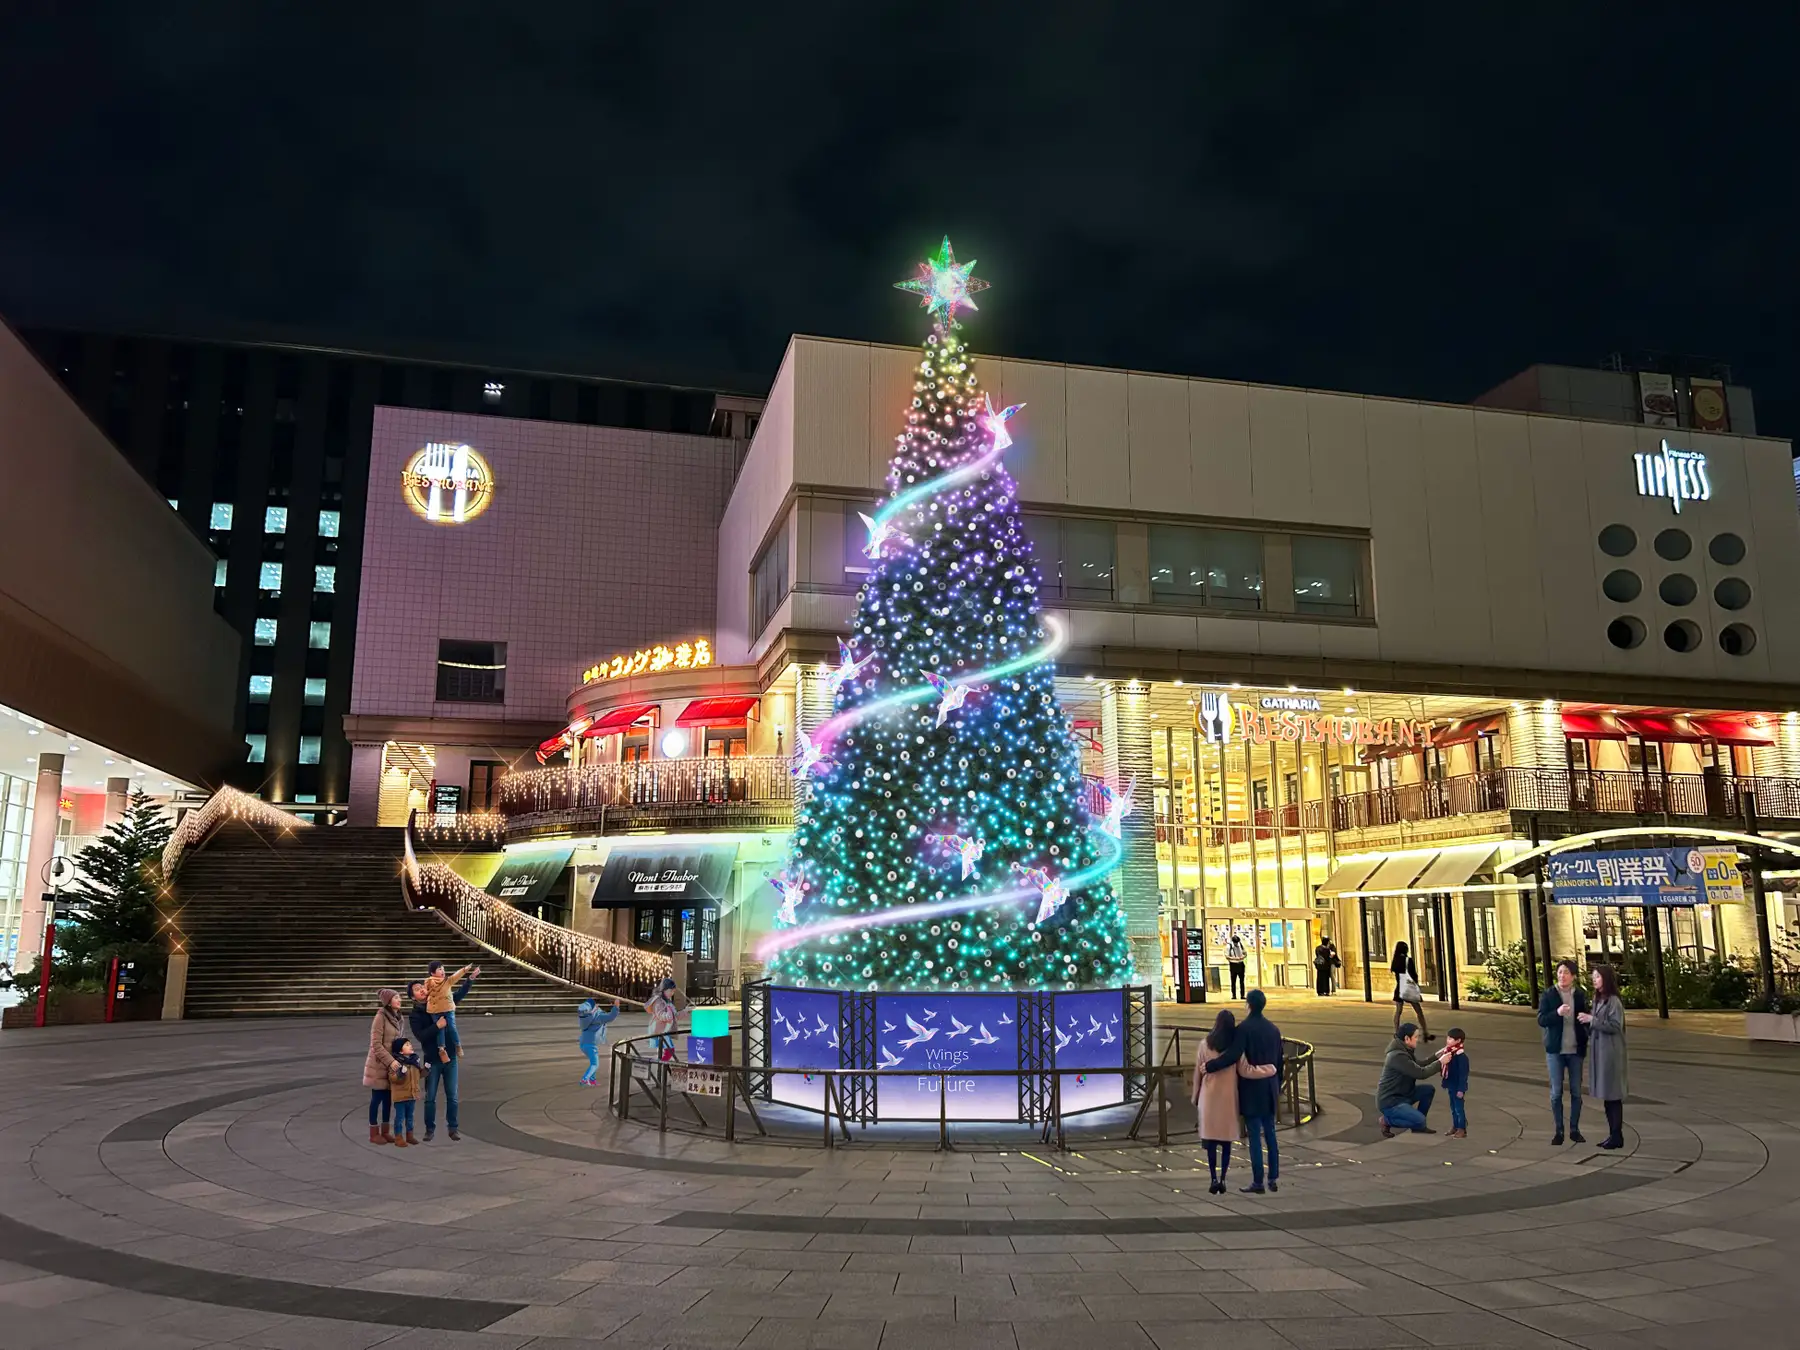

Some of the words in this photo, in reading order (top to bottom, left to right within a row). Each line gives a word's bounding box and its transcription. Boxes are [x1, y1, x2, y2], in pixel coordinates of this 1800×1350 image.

[1634, 439, 1710, 514] TIPNESS
[1261, 698, 1320, 711] GATHARIA
[1235, 702, 1436, 747] RESTAURANT
[627, 871, 659, 883] Mont
[661, 869, 699, 882] Thabor
[1596, 856, 1671, 886] 創業祭
[925, 1049, 970, 1064] Wings
